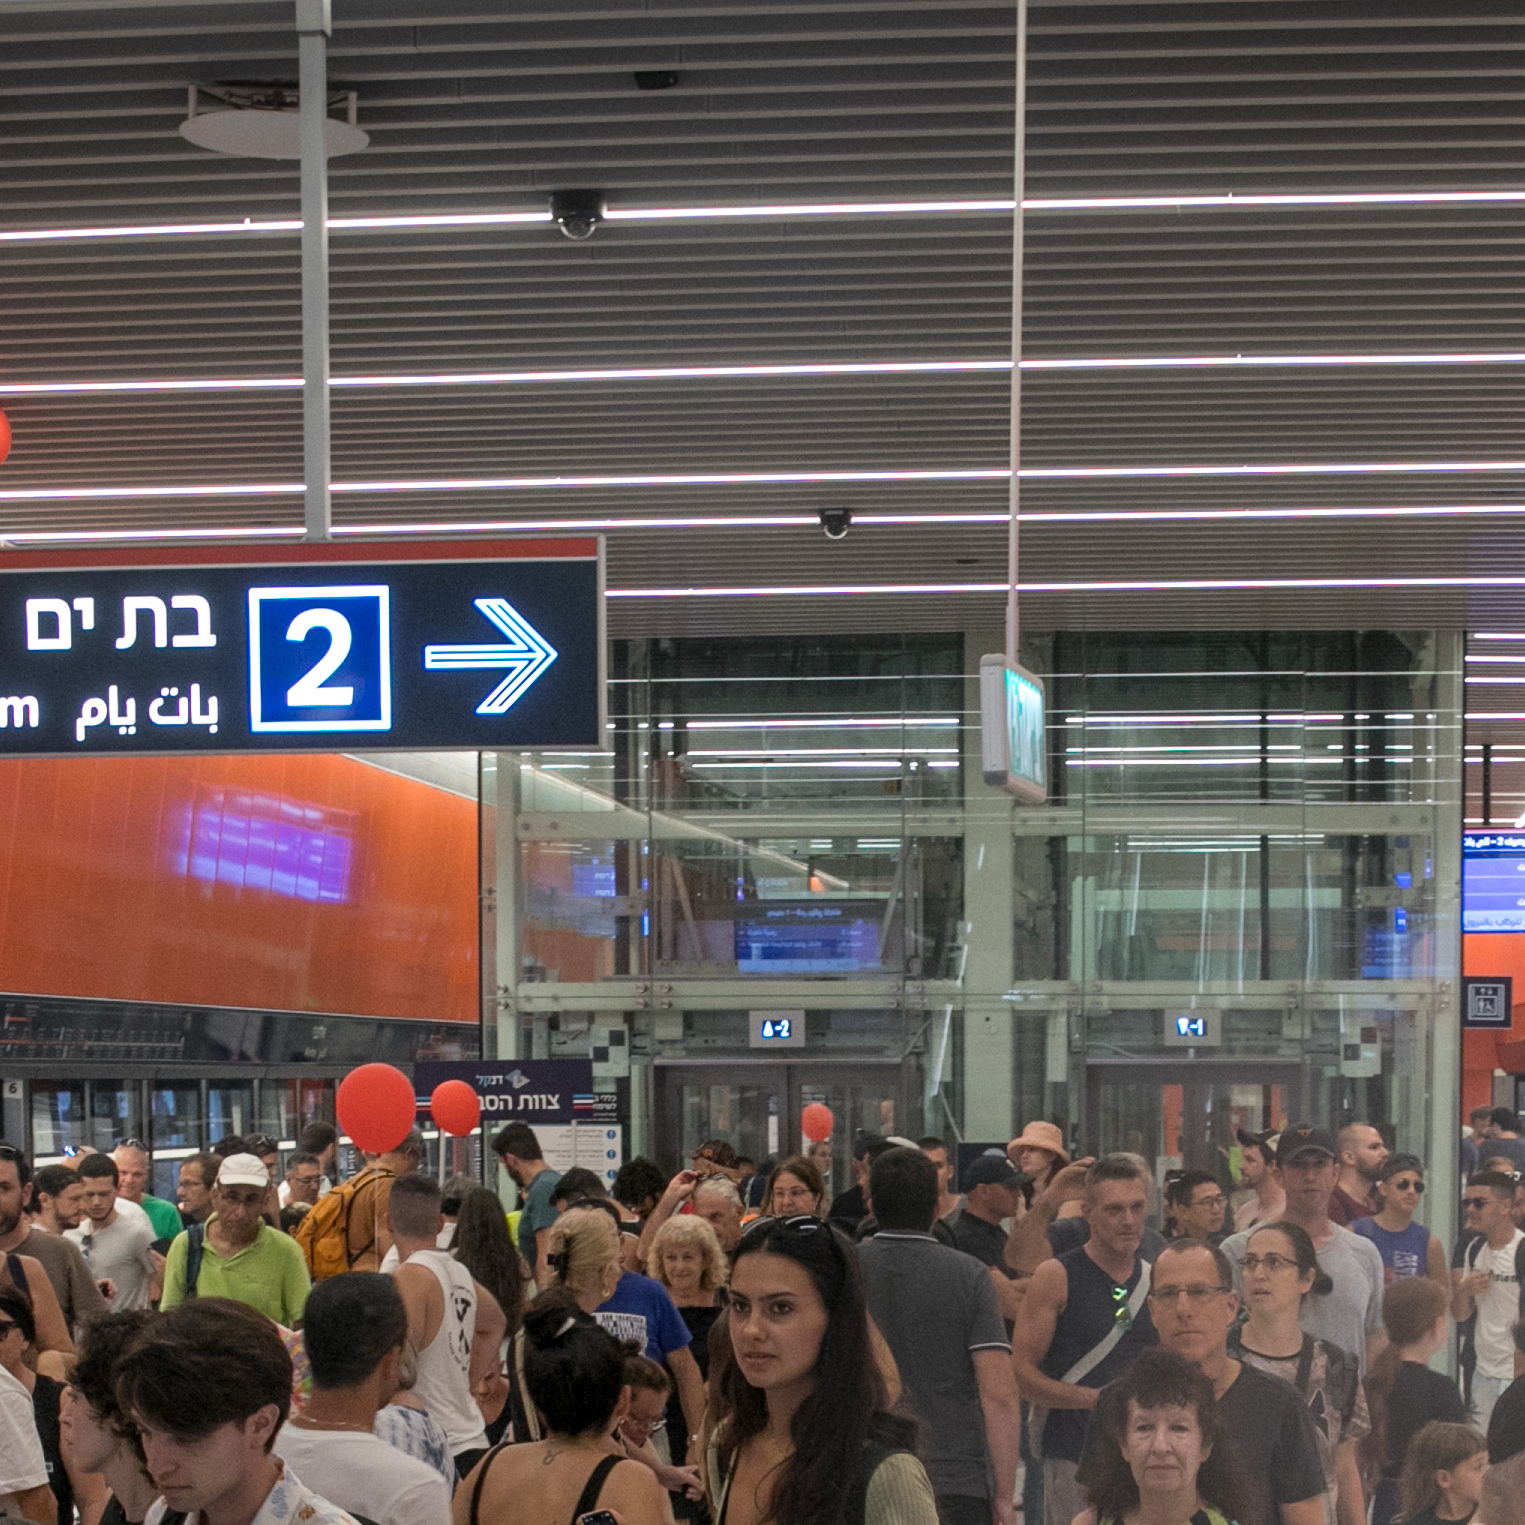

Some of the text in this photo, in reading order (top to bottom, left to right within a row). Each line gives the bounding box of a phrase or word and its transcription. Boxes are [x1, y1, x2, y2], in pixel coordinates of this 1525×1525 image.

[25, 594, 217, 651] בת ים
[284, 607, 355, 708] 2
[75, 683, 219, 742] بات يام
[8, 1082, 18, 1094] 6
[516, 1093, 561, 1111] צוות
